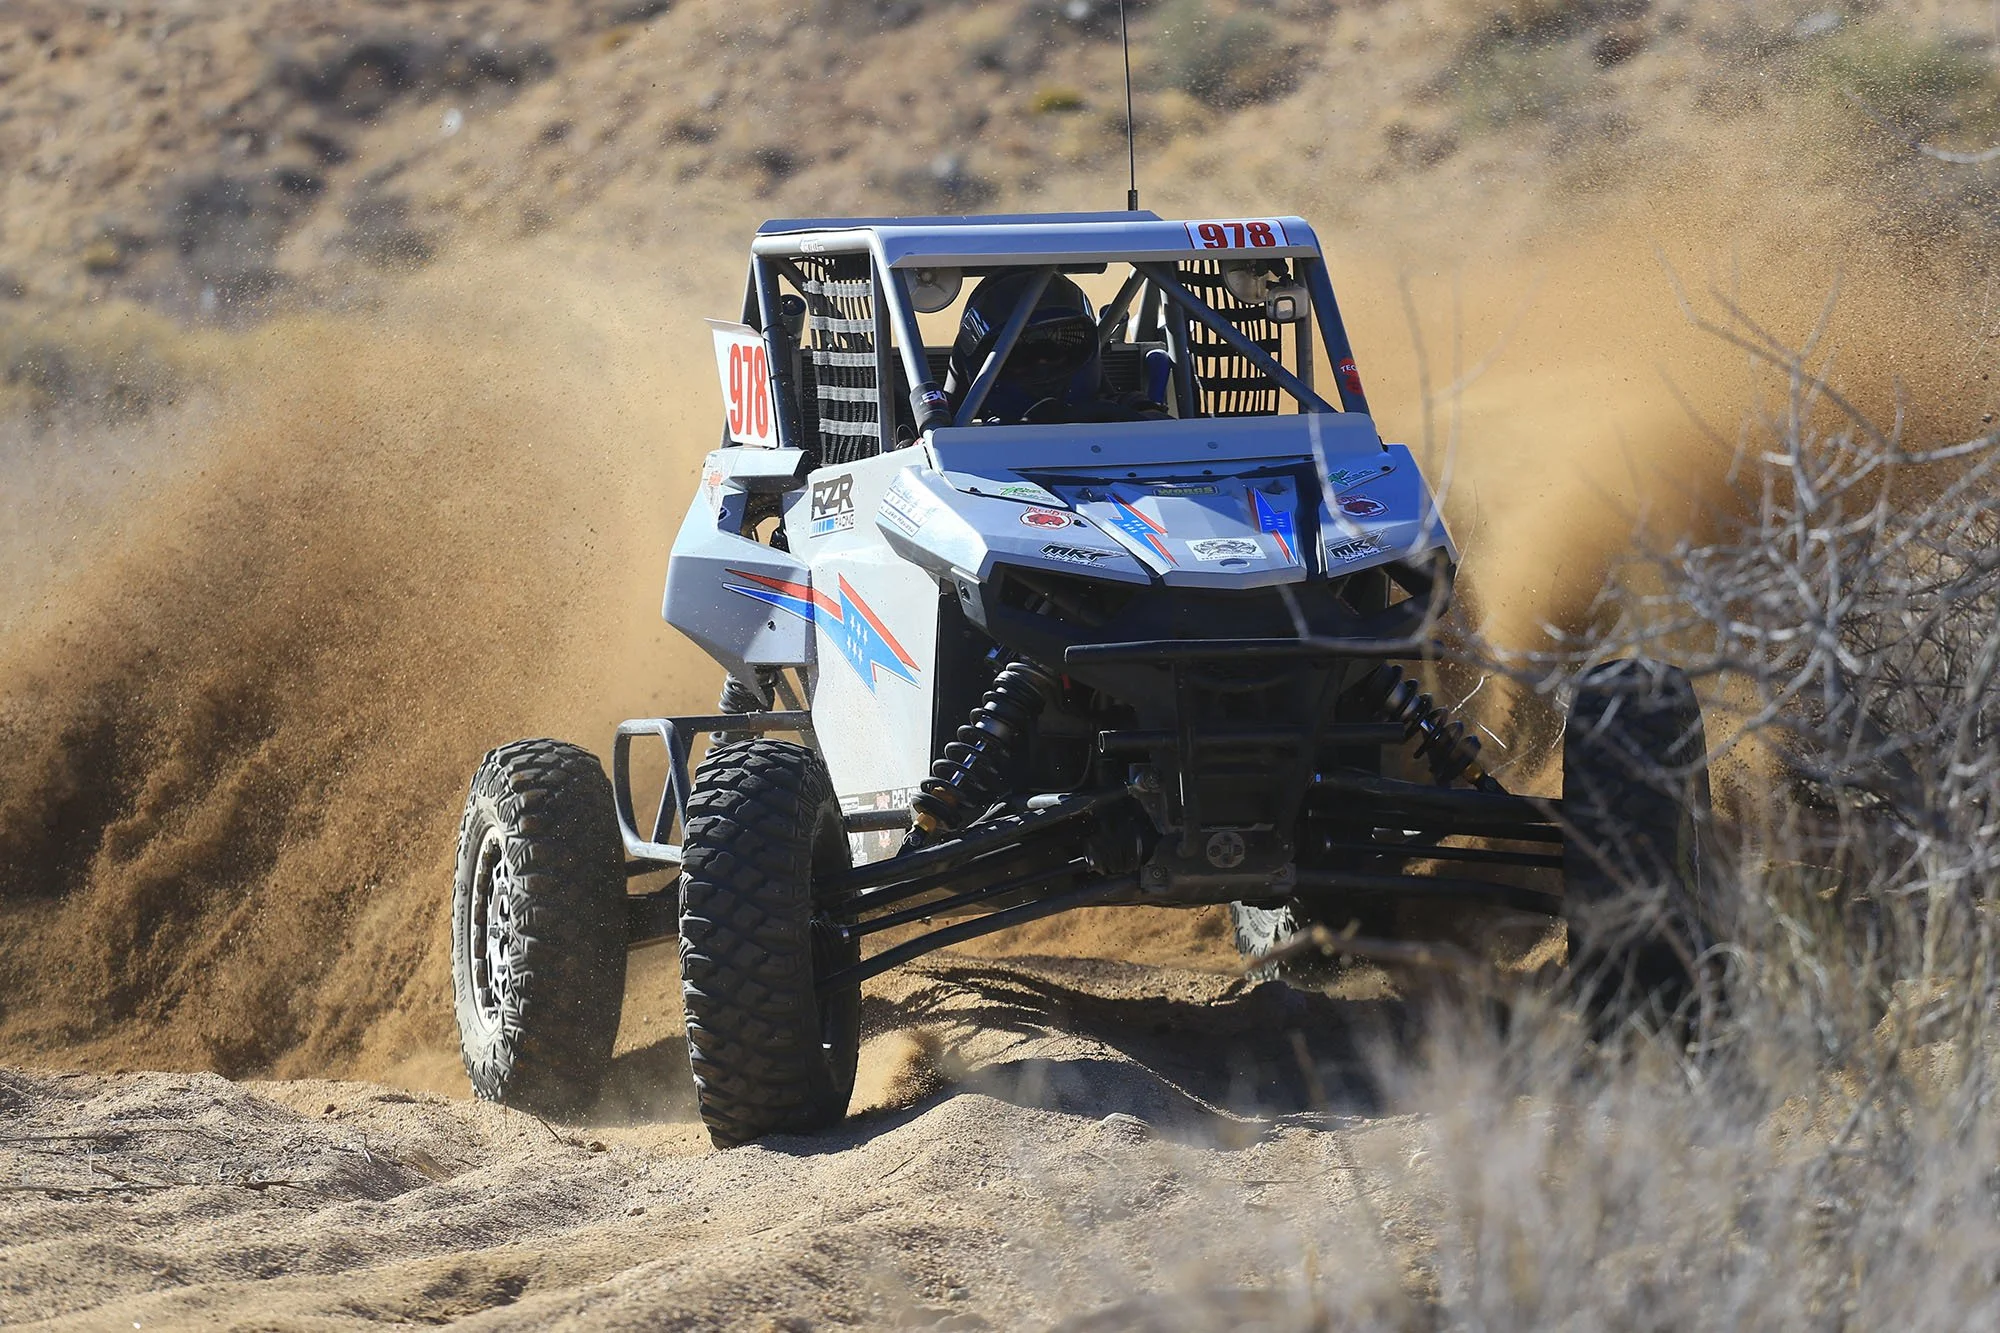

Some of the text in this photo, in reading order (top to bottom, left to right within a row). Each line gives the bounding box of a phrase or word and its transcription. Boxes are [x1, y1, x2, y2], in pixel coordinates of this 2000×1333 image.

[1198, 221, 1277, 249] 978
[729, 342, 768, 438] 978
[811, 473, 853, 521] RZR
